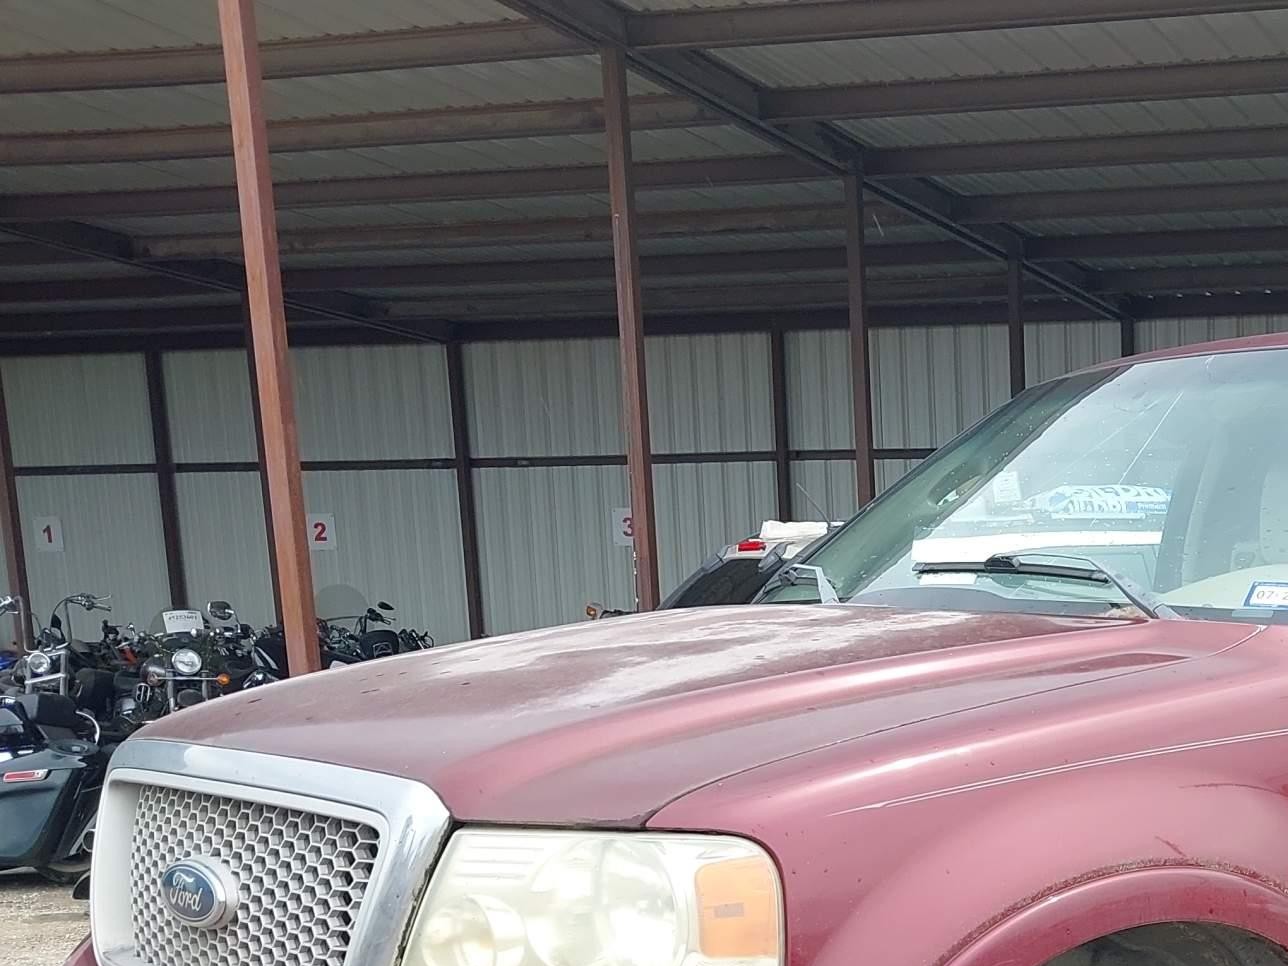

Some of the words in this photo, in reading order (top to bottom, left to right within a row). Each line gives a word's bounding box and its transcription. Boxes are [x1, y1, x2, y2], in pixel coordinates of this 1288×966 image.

[42, 524, 53, 543] 1
[313, 522, 328, 542] 2
[623, 517, 634, 537] 3
[169, 871, 204, 912] Ford
